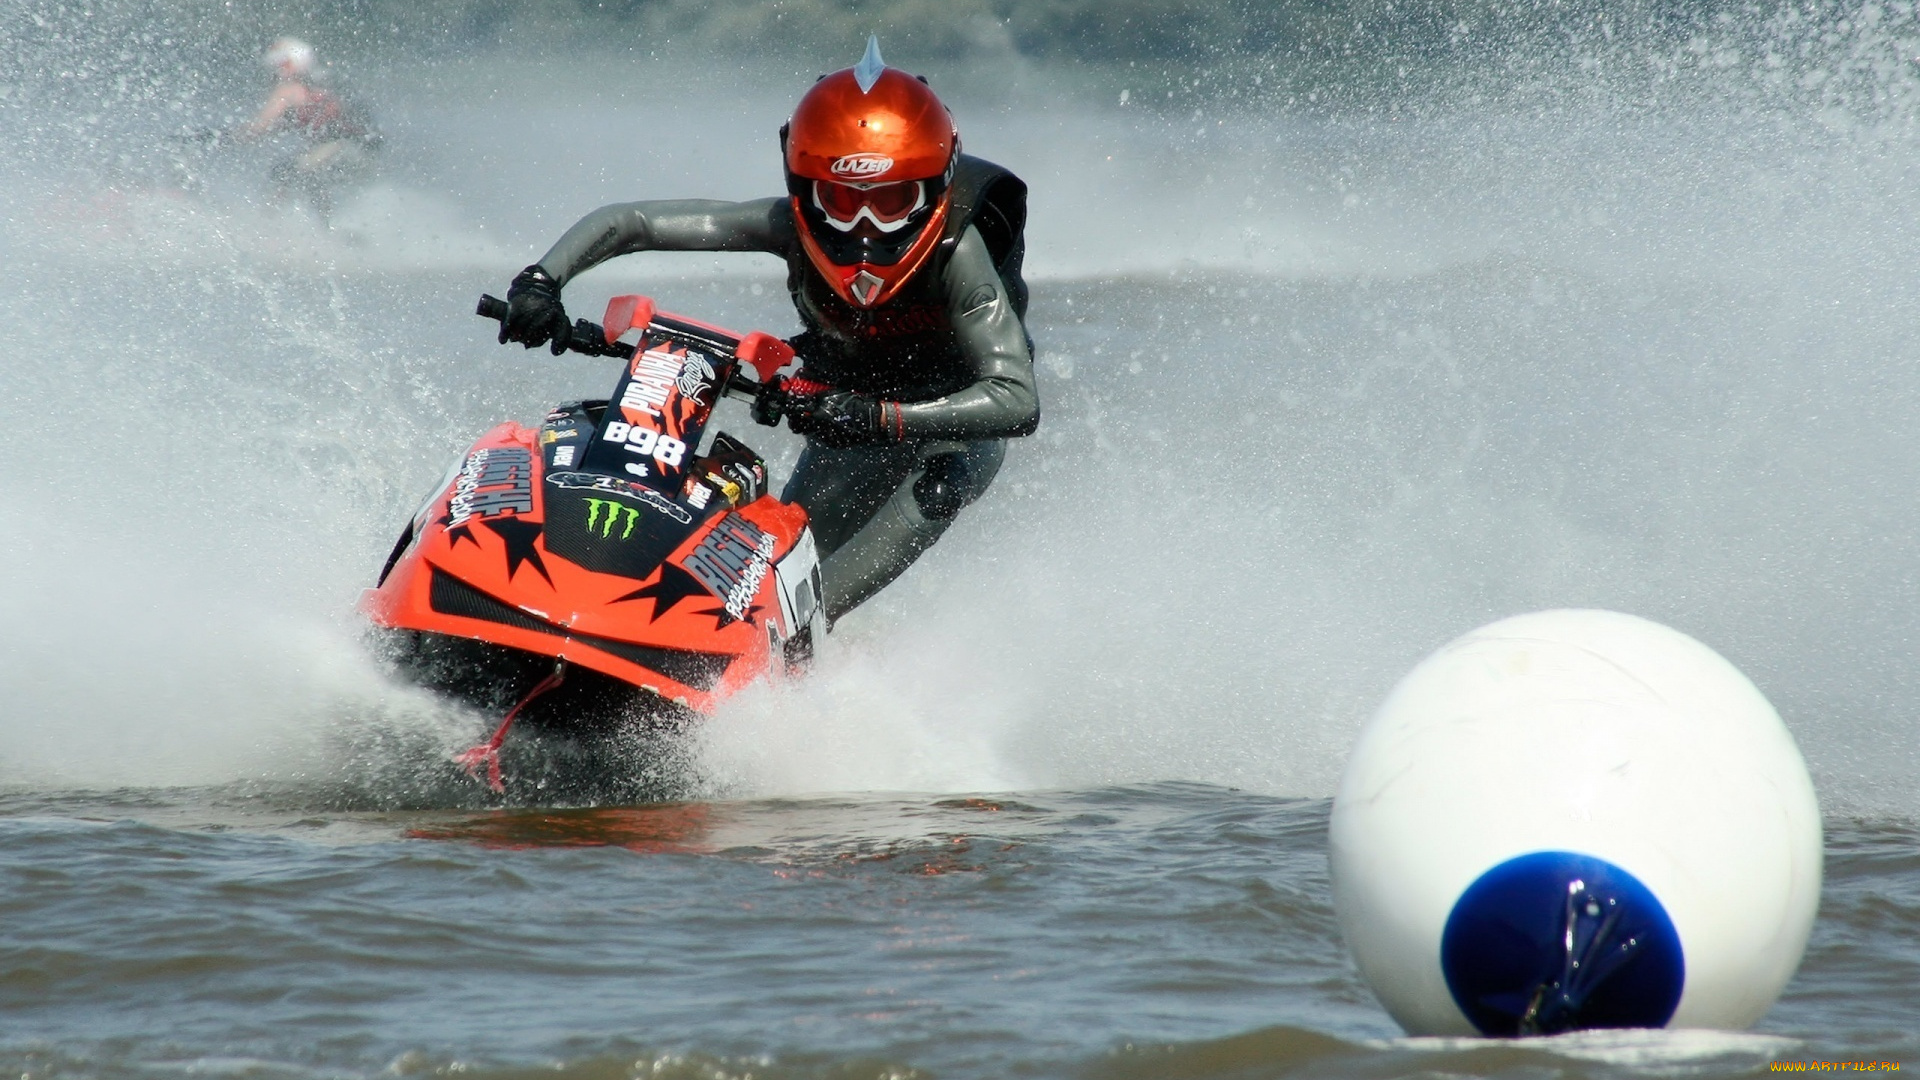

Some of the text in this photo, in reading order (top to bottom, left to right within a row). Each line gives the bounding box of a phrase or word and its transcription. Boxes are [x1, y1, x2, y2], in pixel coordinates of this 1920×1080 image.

[836, 158, 891, 174] LAZER
[619, 350, 686, 417] PIRANHA
[675, 350, 716, 406] Racing
[552, 445, 575, 467] uvex
[602, 421, 686, 466] B98
[687, 482, 712, 510] uvex
